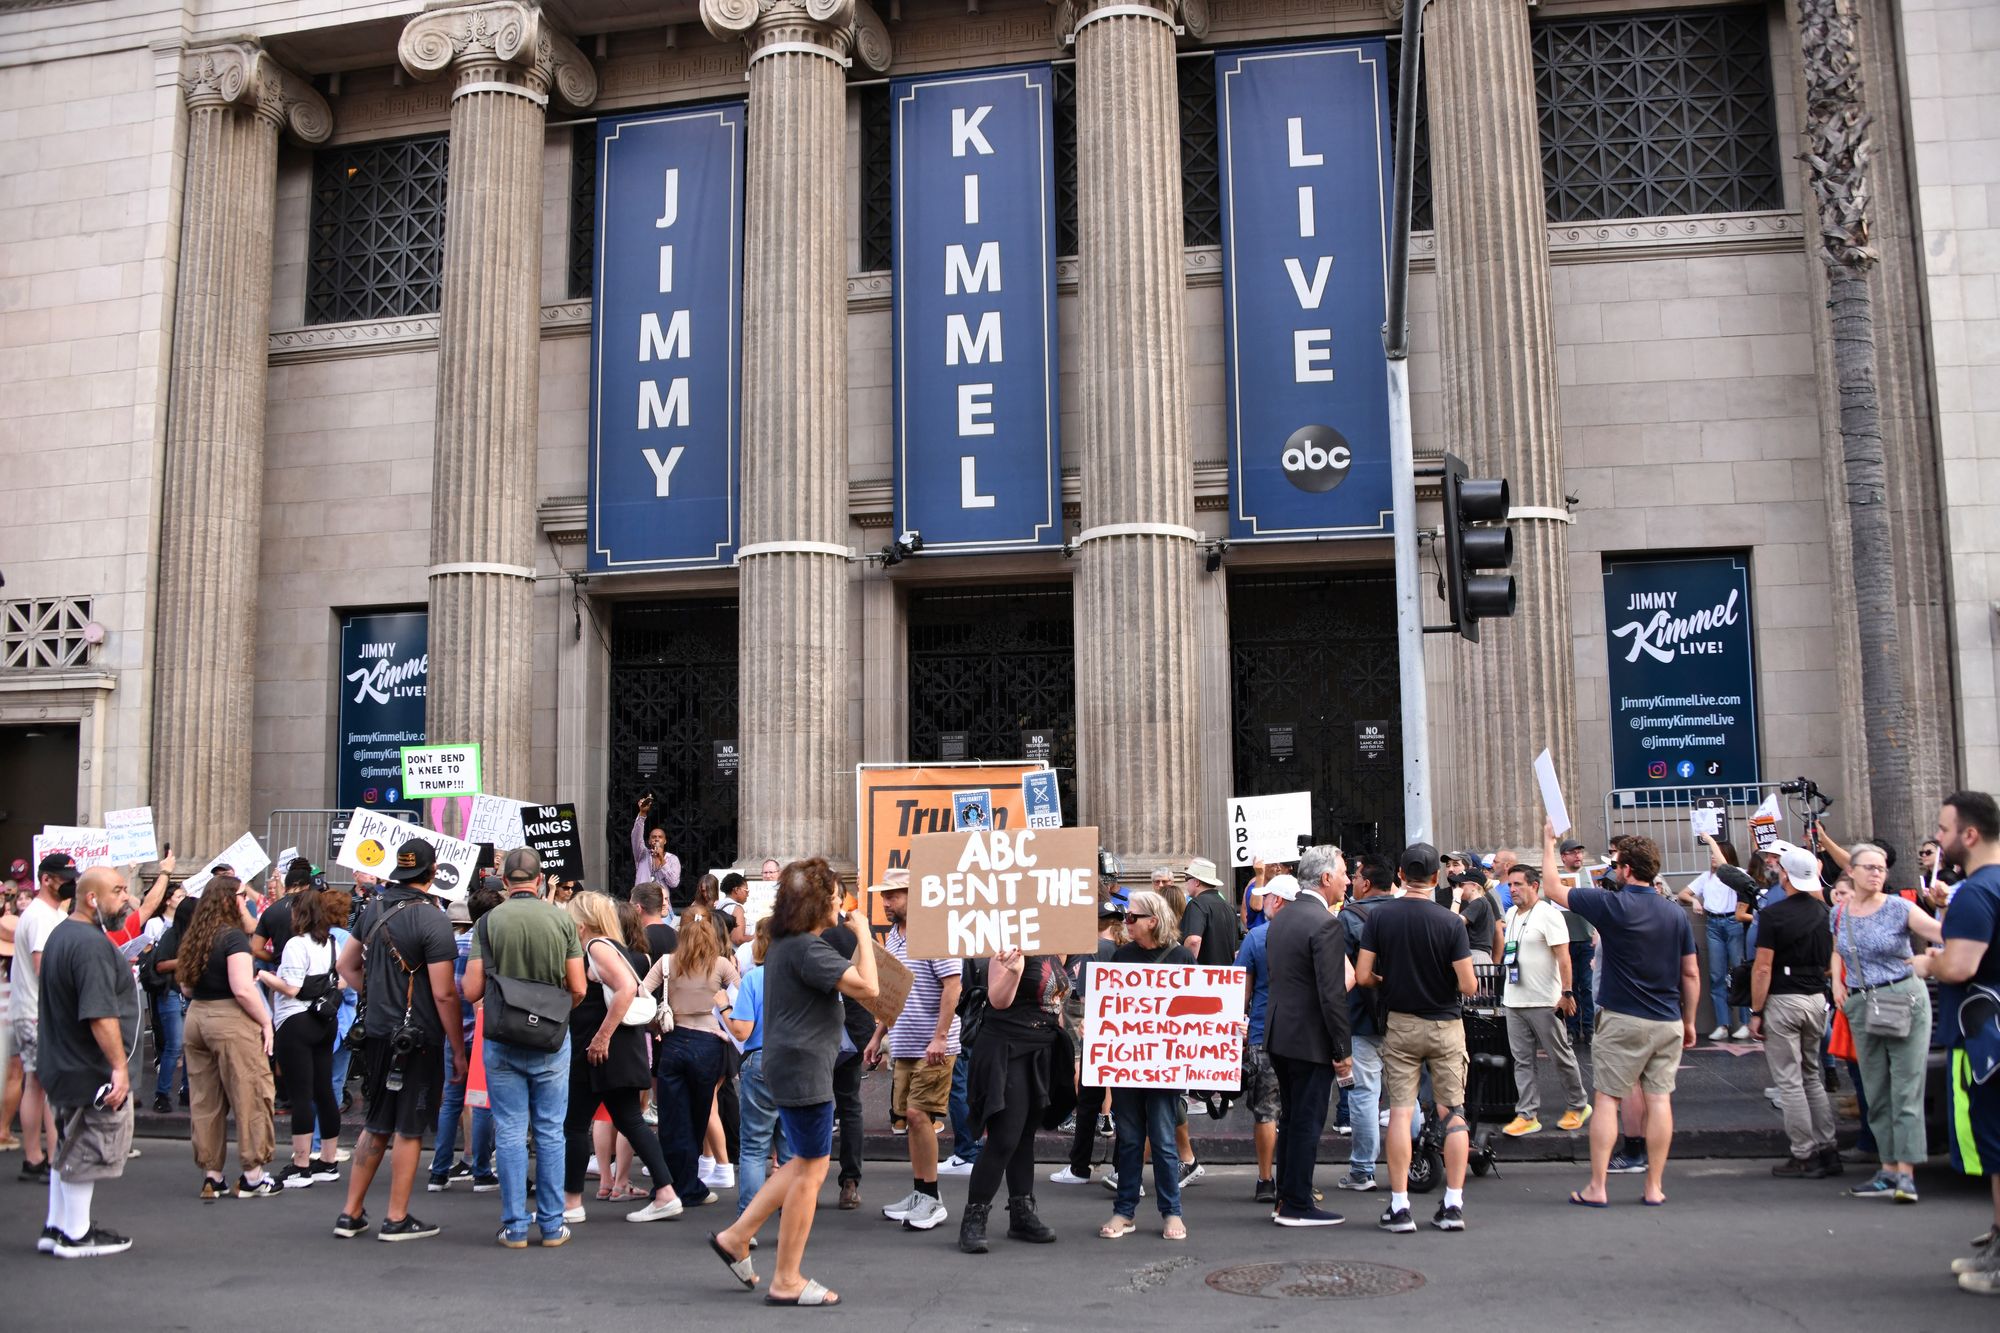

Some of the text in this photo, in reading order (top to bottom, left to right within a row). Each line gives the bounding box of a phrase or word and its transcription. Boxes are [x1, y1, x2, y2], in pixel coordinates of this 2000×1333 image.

[1283, 117, 1334, 383] LIVE
[944, 105, 1003, 508] KIMMEL
[638, 168, 691, 497] JIMMY
[1282, 440, 1350, 471] abc
[1627, 592, 1677, 611] JIMMY
[1612, 588, 1739, 664] Kimmel
[358, 642, 396, 659] JIMMY
[1680, 642, 1723, 655] LIVE!
[346, 654, 428, 705] Kimme
[394, 686, 427, 697] LIVE!
[1620, 694, 1741, 711] JimmyKimmelLive.com
[1630, 714, 1735, 730] @JimmyKimmelLive
[348, 731, 426, 744] JimmyKimmelLive.c
[1365, 726, 1378, 735] NO
[1032, 735, 1043, 743] NO
[1641, 733, 1725, 749] @JimmyKimmel
[353, 749, 400, 762] @JimmyKim
[722, 745, 734, 753] NO
[407, 753, 465, 764] DON'T BEND
[408, 765, 460, 775] A KNEE TO
[420, 780, 464, 789] TRUMP!!!
[477, 795, 507, 814] FIGHT
[959, 795, 983, 803] SOLIDARITY
[539, 806, 558, 819] NO
[896, 799, 1008, 837] Trup
[506, 818, 522, 834] FO
[525, 820, 572, 837] KINGS
[1030, 816, 1058, 828] FREE
[469, 829, 494, 844] FREE
[534, 839, 571, 850] UNLESS
[74, 844, 109, 858] SPEECH
[545, 850, 560, 858] WE
[957, 829, 1038, 873] ABC
[434, 869, 458, 885] abc
[920, 868, 1094, 908] BENT THE
[948, 908, 1040, 957] KNEE
[1095, 967, 1247, 991] PROTECT THE
[1099, 992, 1168, 1018] FIRST
[1099, 1020, 1240, 1037] AMENDMENT
[1089, 1038, 1240, 1065] FIGHT TRUMP'S
[1097, 1063, 1241, 1085] FACSIST TAKEOVER
